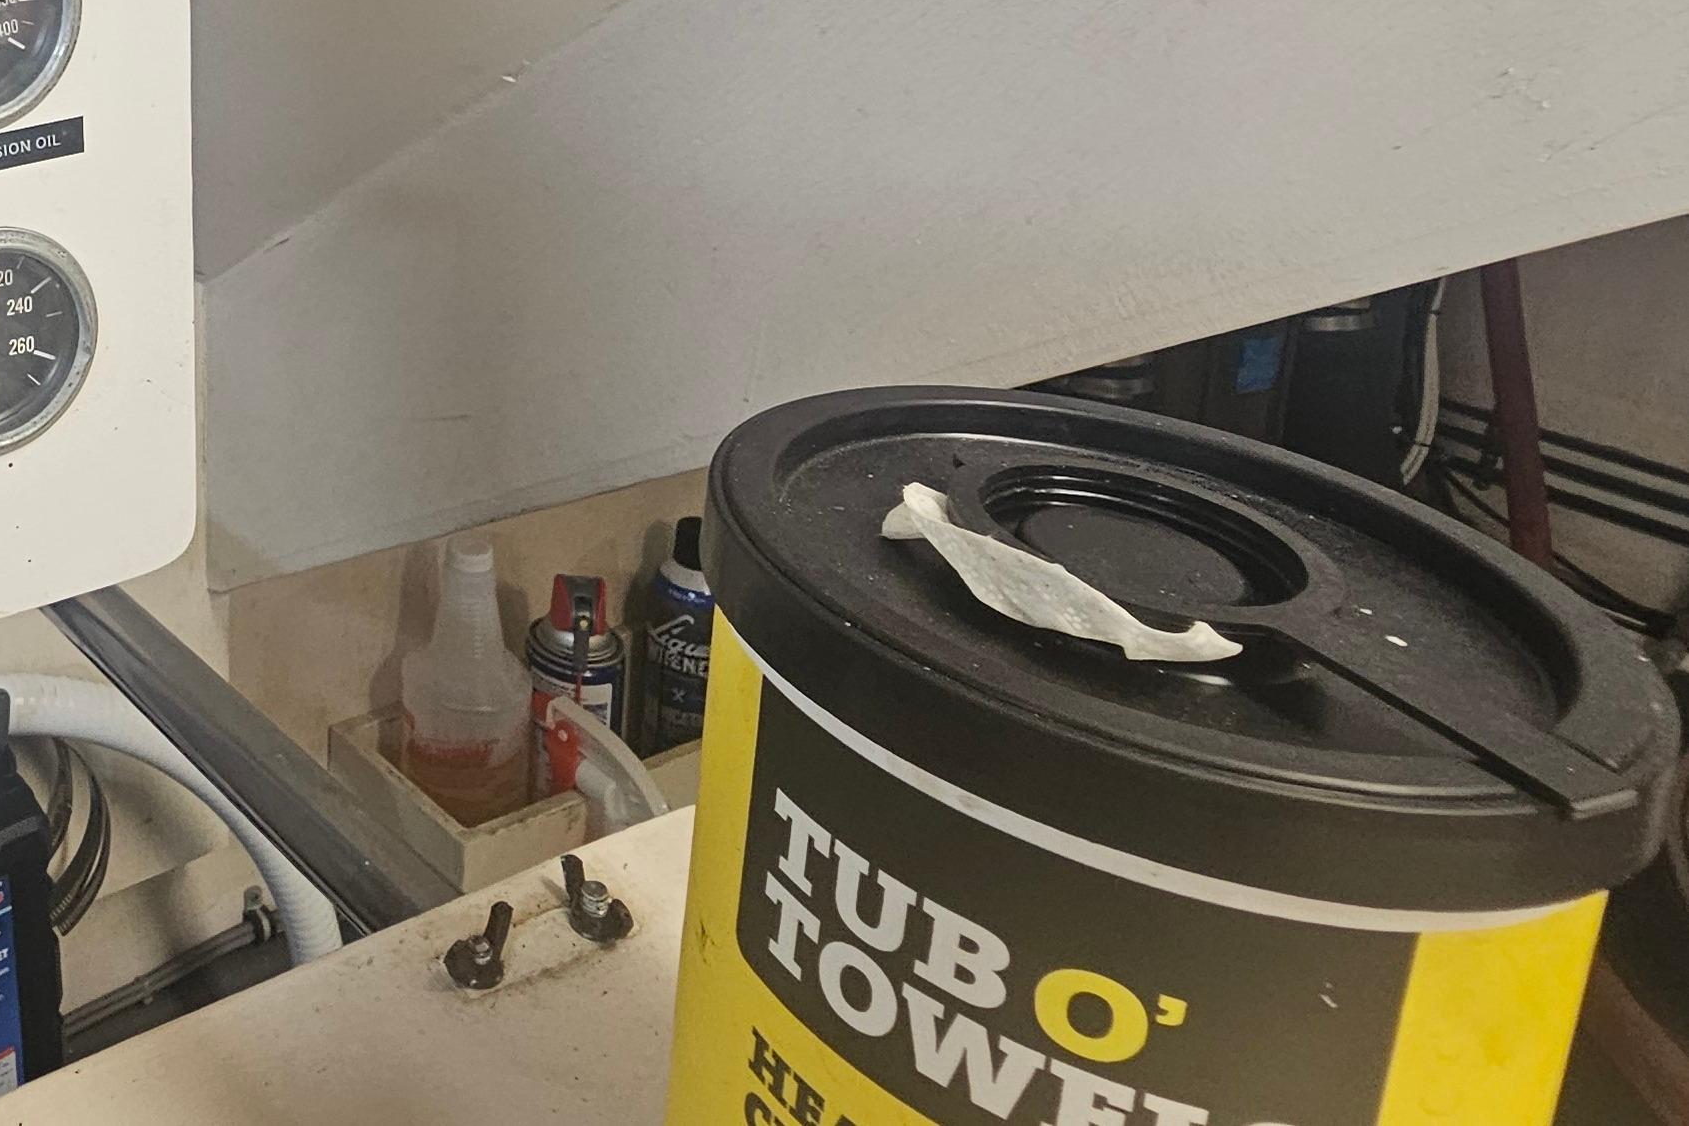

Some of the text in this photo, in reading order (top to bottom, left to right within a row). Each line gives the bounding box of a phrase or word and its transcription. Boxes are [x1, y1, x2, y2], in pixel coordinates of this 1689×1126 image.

[35, 134, 61, 153] OIL
[6, 295, 33, 316] 240
[8, 335, 35, 356] 260
[775, 787, 1189, 1062] TUB O'
[765, 871, 1303, 1126] TOWE
